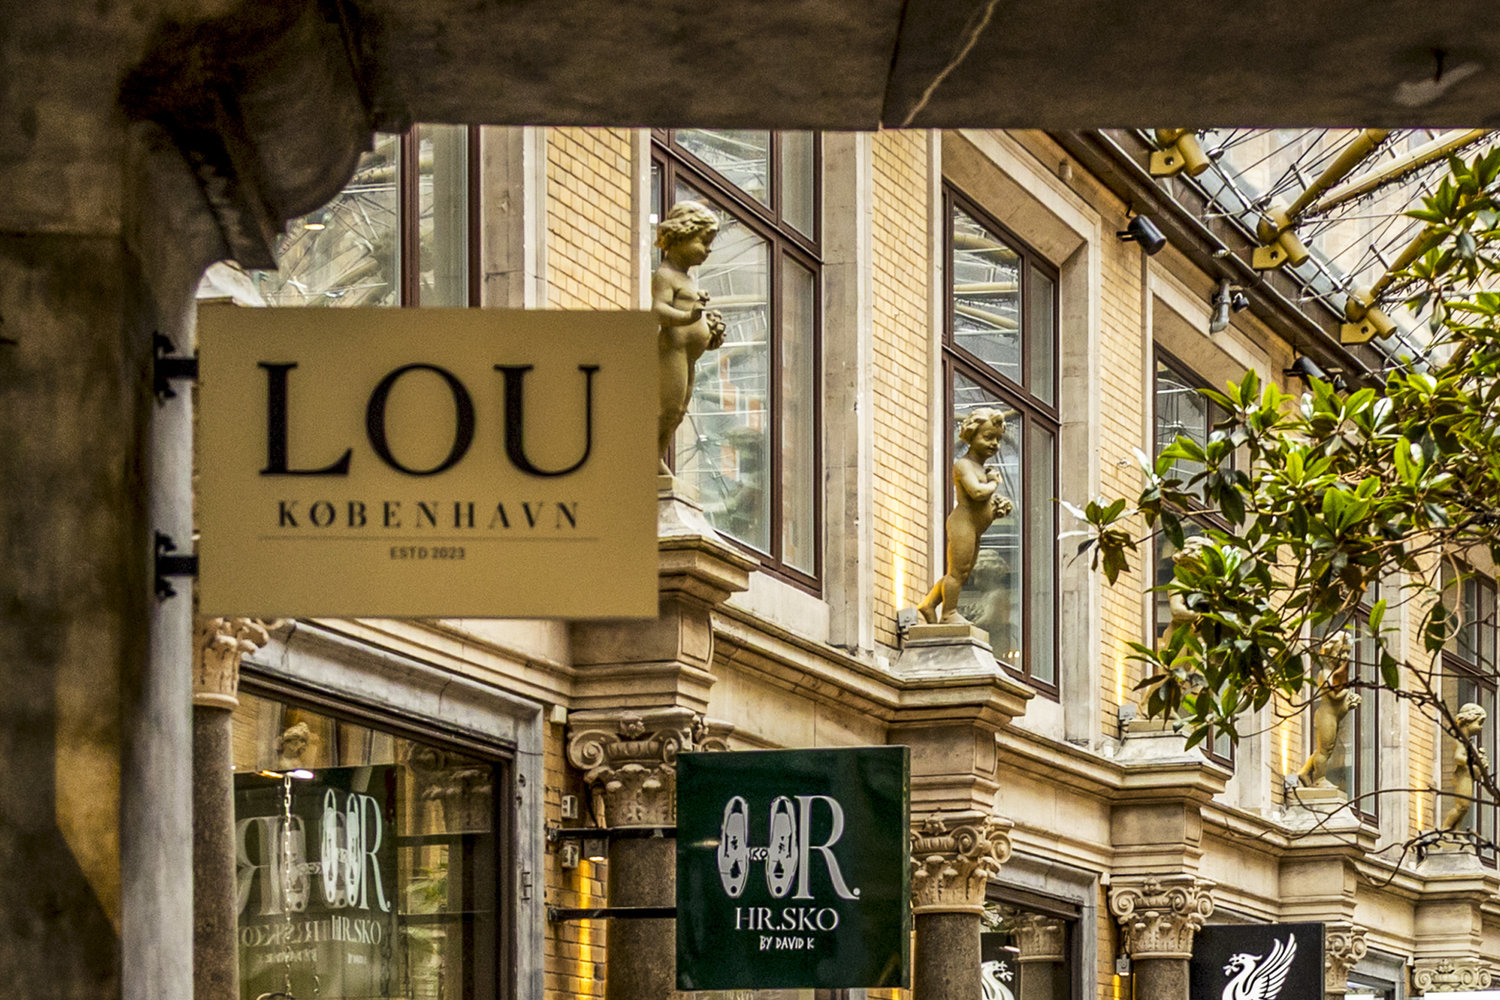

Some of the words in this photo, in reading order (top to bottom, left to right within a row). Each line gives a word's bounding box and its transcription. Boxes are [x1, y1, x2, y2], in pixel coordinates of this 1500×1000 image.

[257, 361, 601, 477] LOU
[277, 502, 578, 528] KØBENHAVN
[390, 547, 428, 560] ESTD
[432, 547, 466, 560] 2023
[735, 907, 841, 931] HR.SKO
[760, 935, 773, 950] BY
[775, 935, 804, 950] DAVID
[807, 936, 815, 950] K
